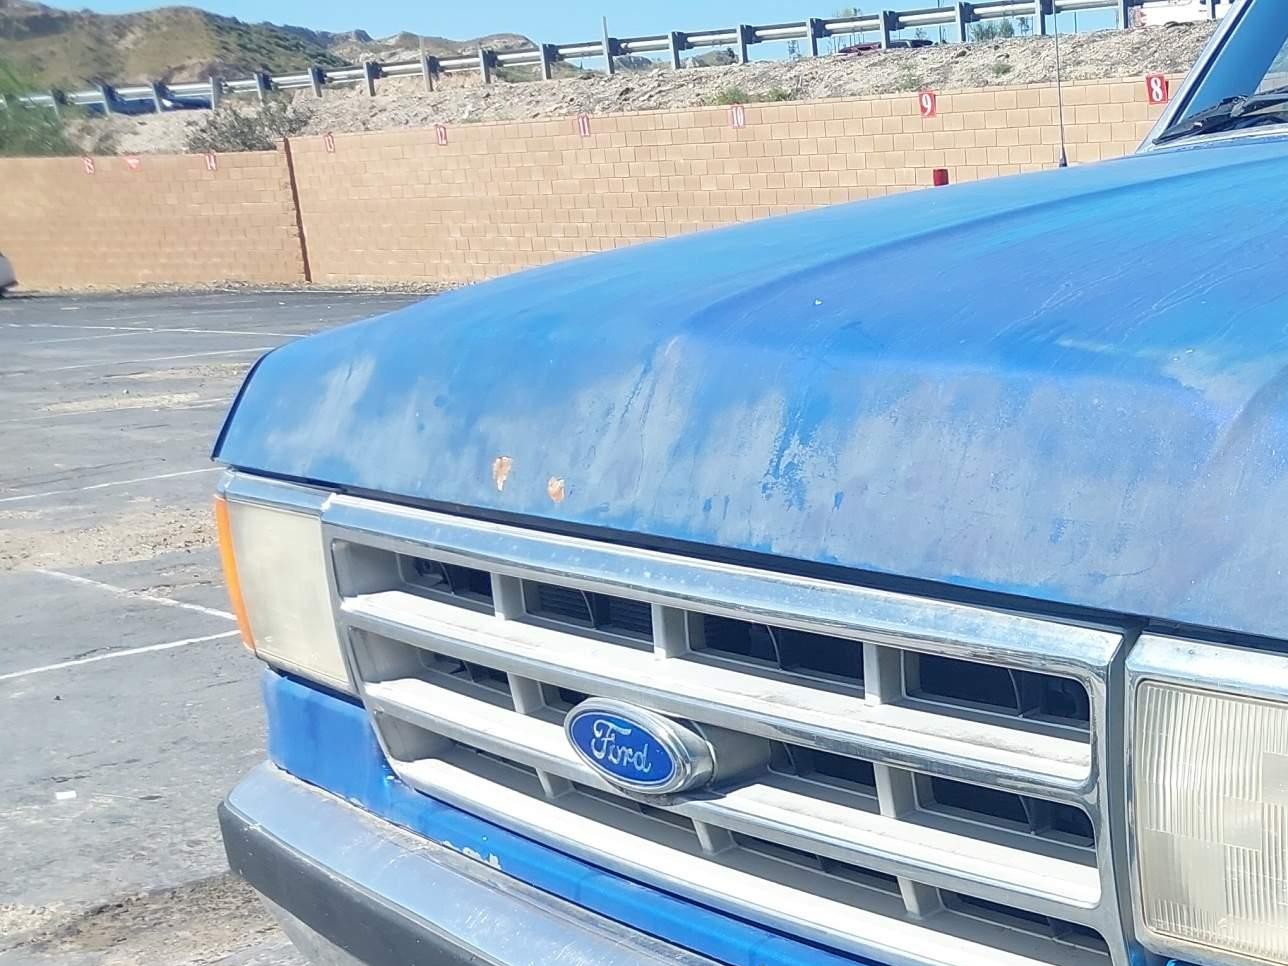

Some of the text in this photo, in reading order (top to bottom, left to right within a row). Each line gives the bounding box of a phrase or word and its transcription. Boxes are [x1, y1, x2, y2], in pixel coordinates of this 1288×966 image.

[1150, 76, 1163, 102] 8
[921, 93, 932, 116] 9
[579, 115, 590, 136] 11
[732, 106, 745, 128] 10
[590, 718, 653, 774] Ford
